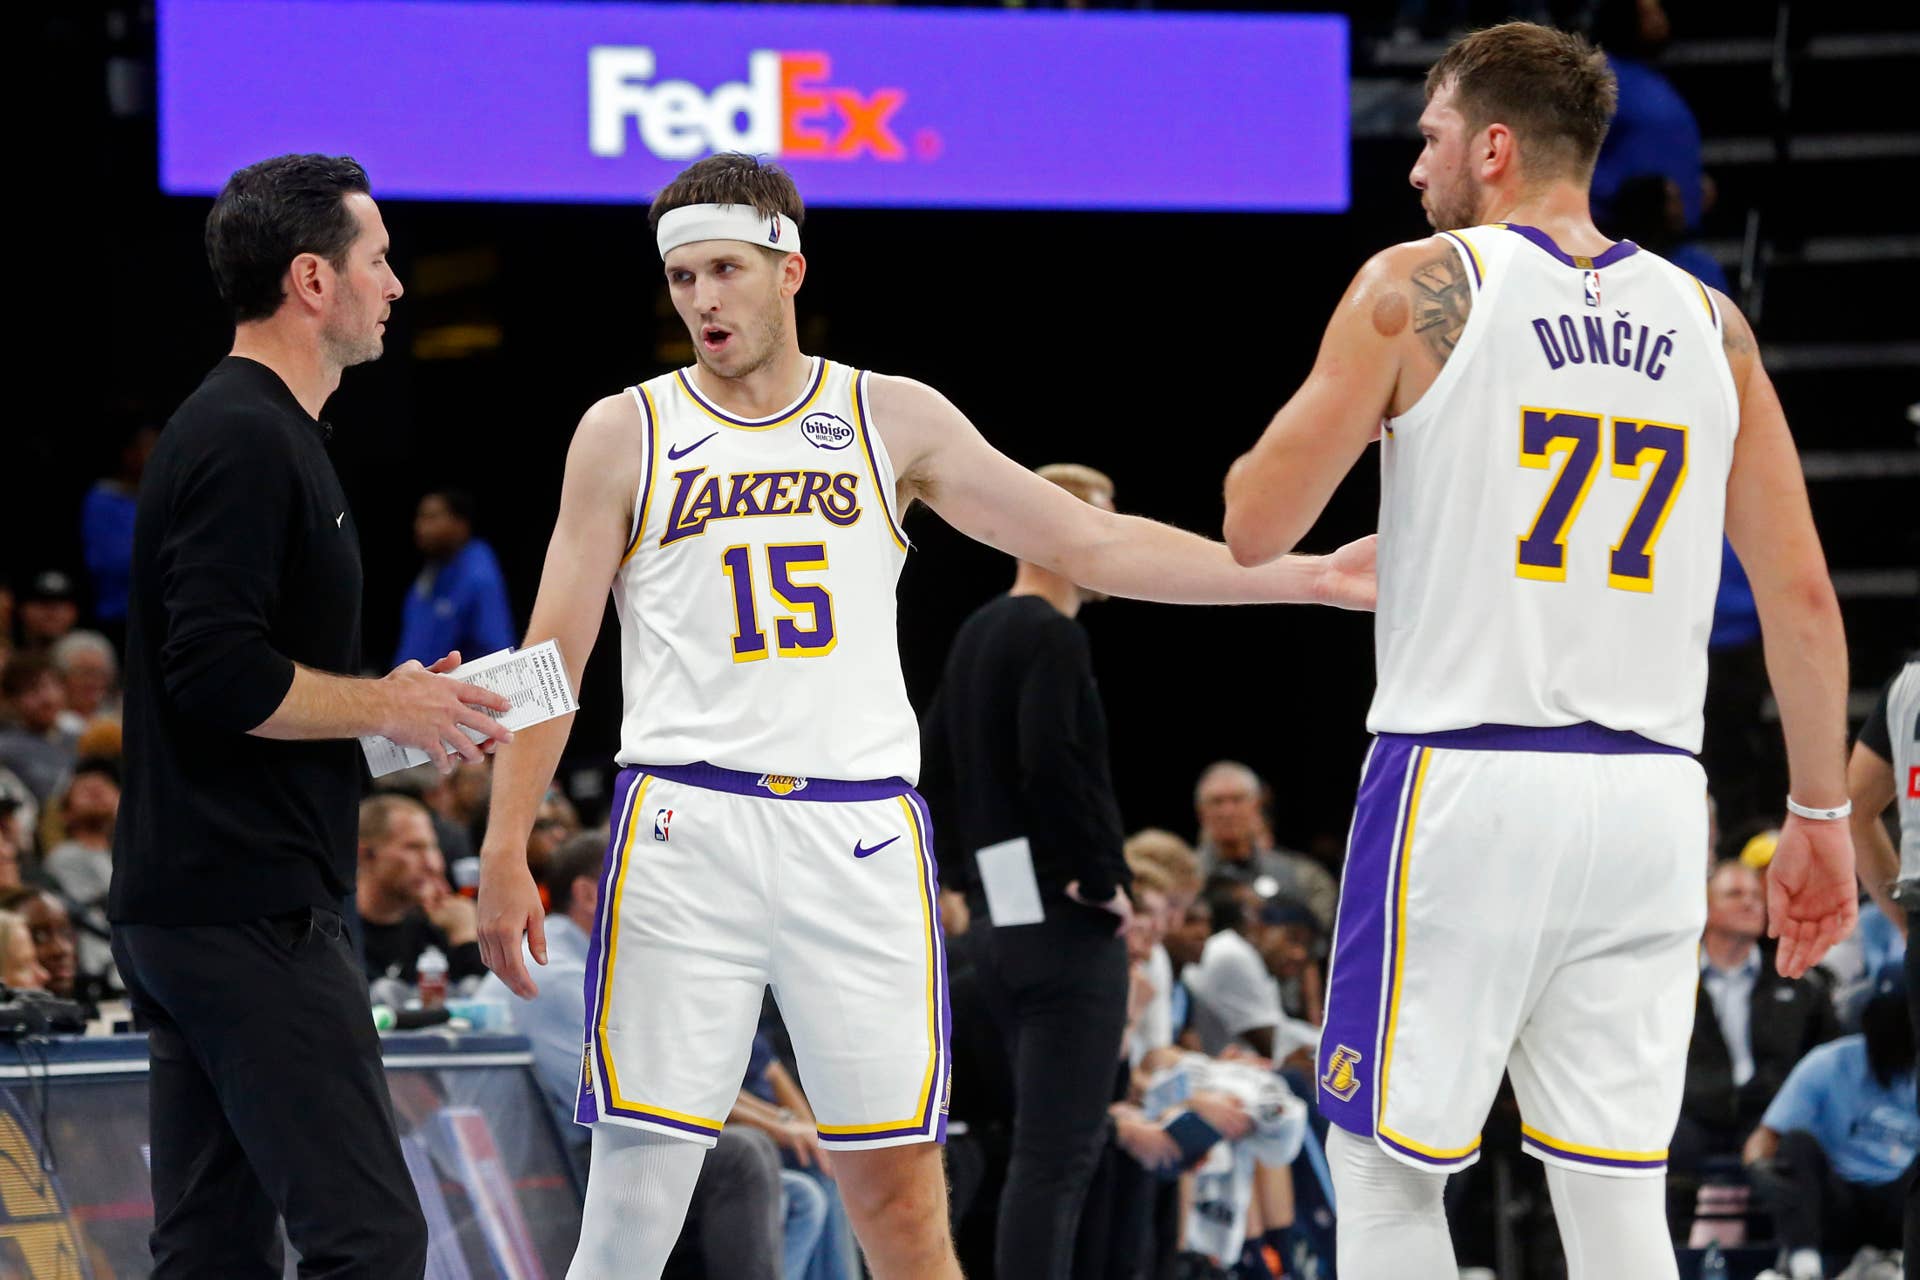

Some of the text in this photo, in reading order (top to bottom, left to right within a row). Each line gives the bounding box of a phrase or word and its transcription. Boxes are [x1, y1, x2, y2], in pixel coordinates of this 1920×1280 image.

[589, 46, 905, 159] FedEx
[1532, 310, 1677, 381] DONČIĆ
[805, 421, 851, 440] bibigo
[659, 465, 863, 549] LAKERS
[1515, 405, 1689, 593] 77
[720, 541, 838, 664] 15
[536, 669, 546, 686] ZOOM
[540, 655, 550, 671] AWAY
[546, 670, 559, 699] (THRUST)
[547, 652, 558, 674] HORNS
